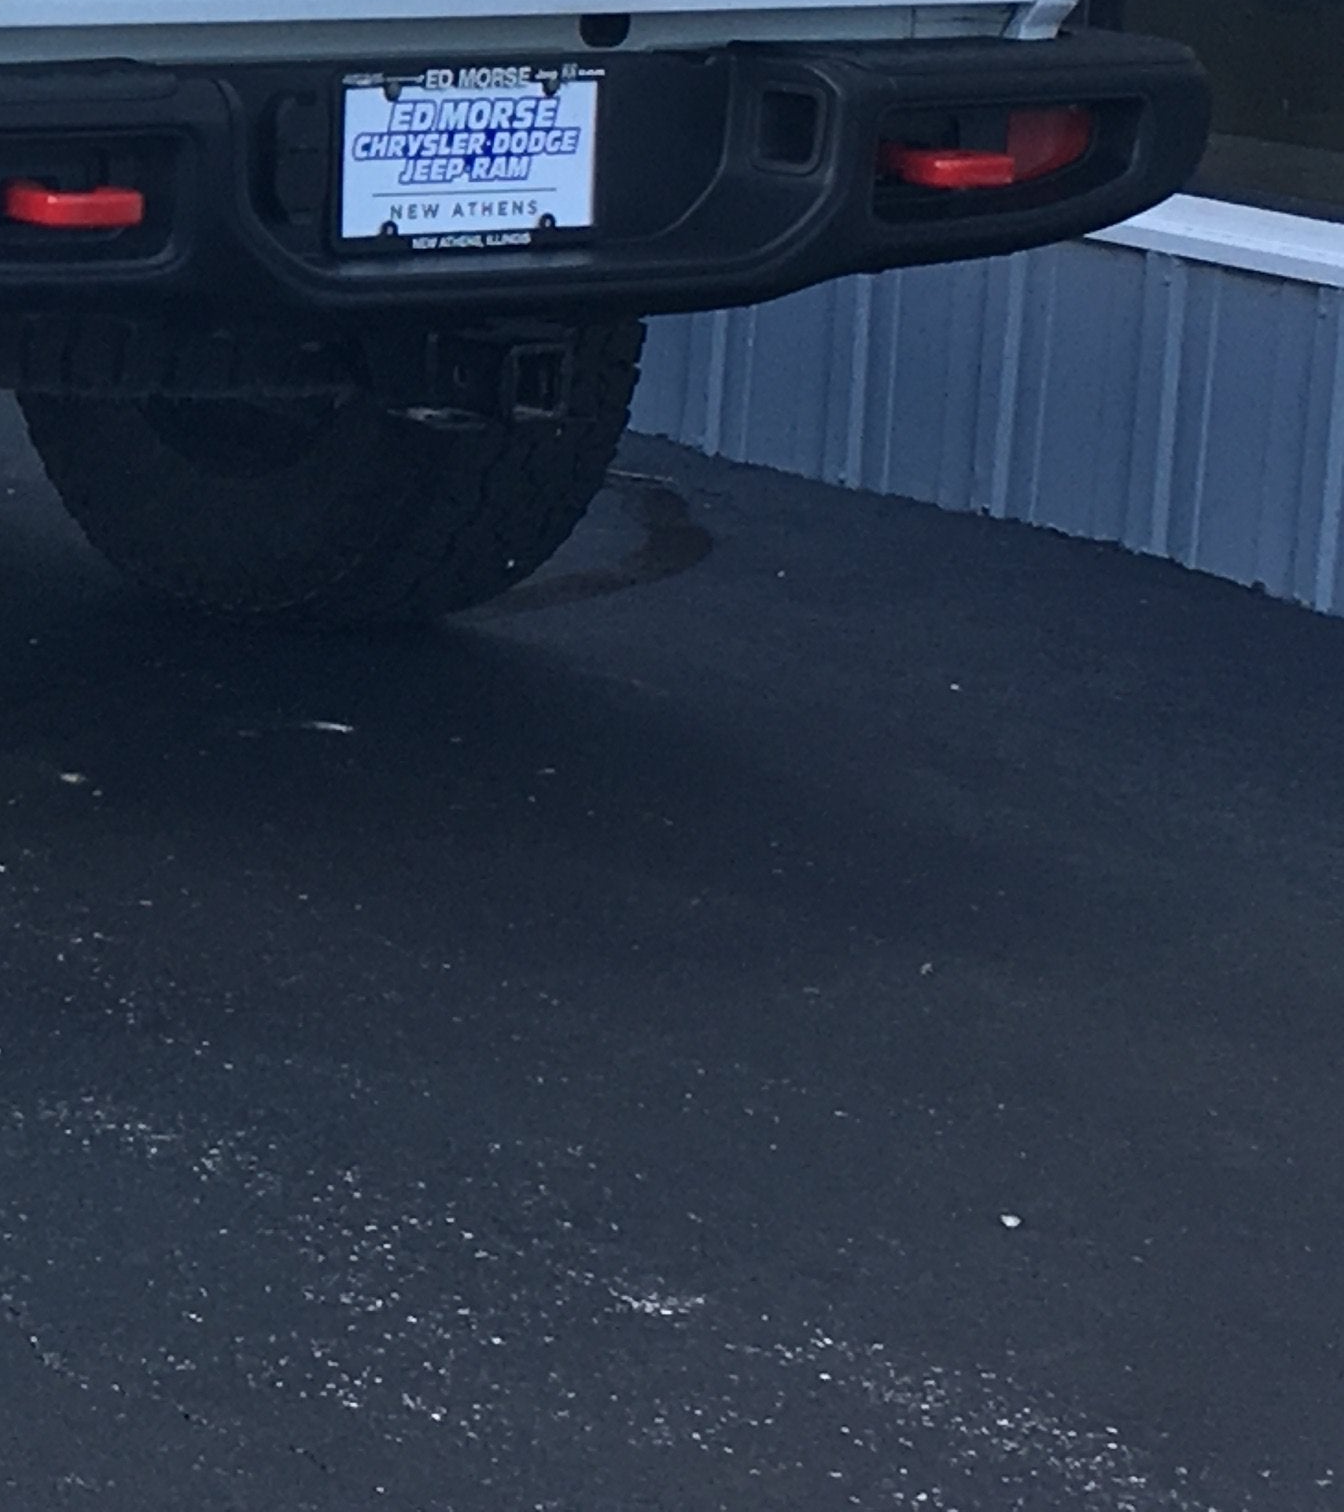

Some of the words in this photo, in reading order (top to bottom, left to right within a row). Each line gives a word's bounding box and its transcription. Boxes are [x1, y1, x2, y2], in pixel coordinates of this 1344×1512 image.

[425, 69, 454, 88] ED
[459, 67, 531, 87] MORSE
[389, 100, 436, 131] ED
[438, 97, 558, 131] MORSE
[390, 203, 439, 220] NEW
[451, 199, 538, 218] ATHENS
